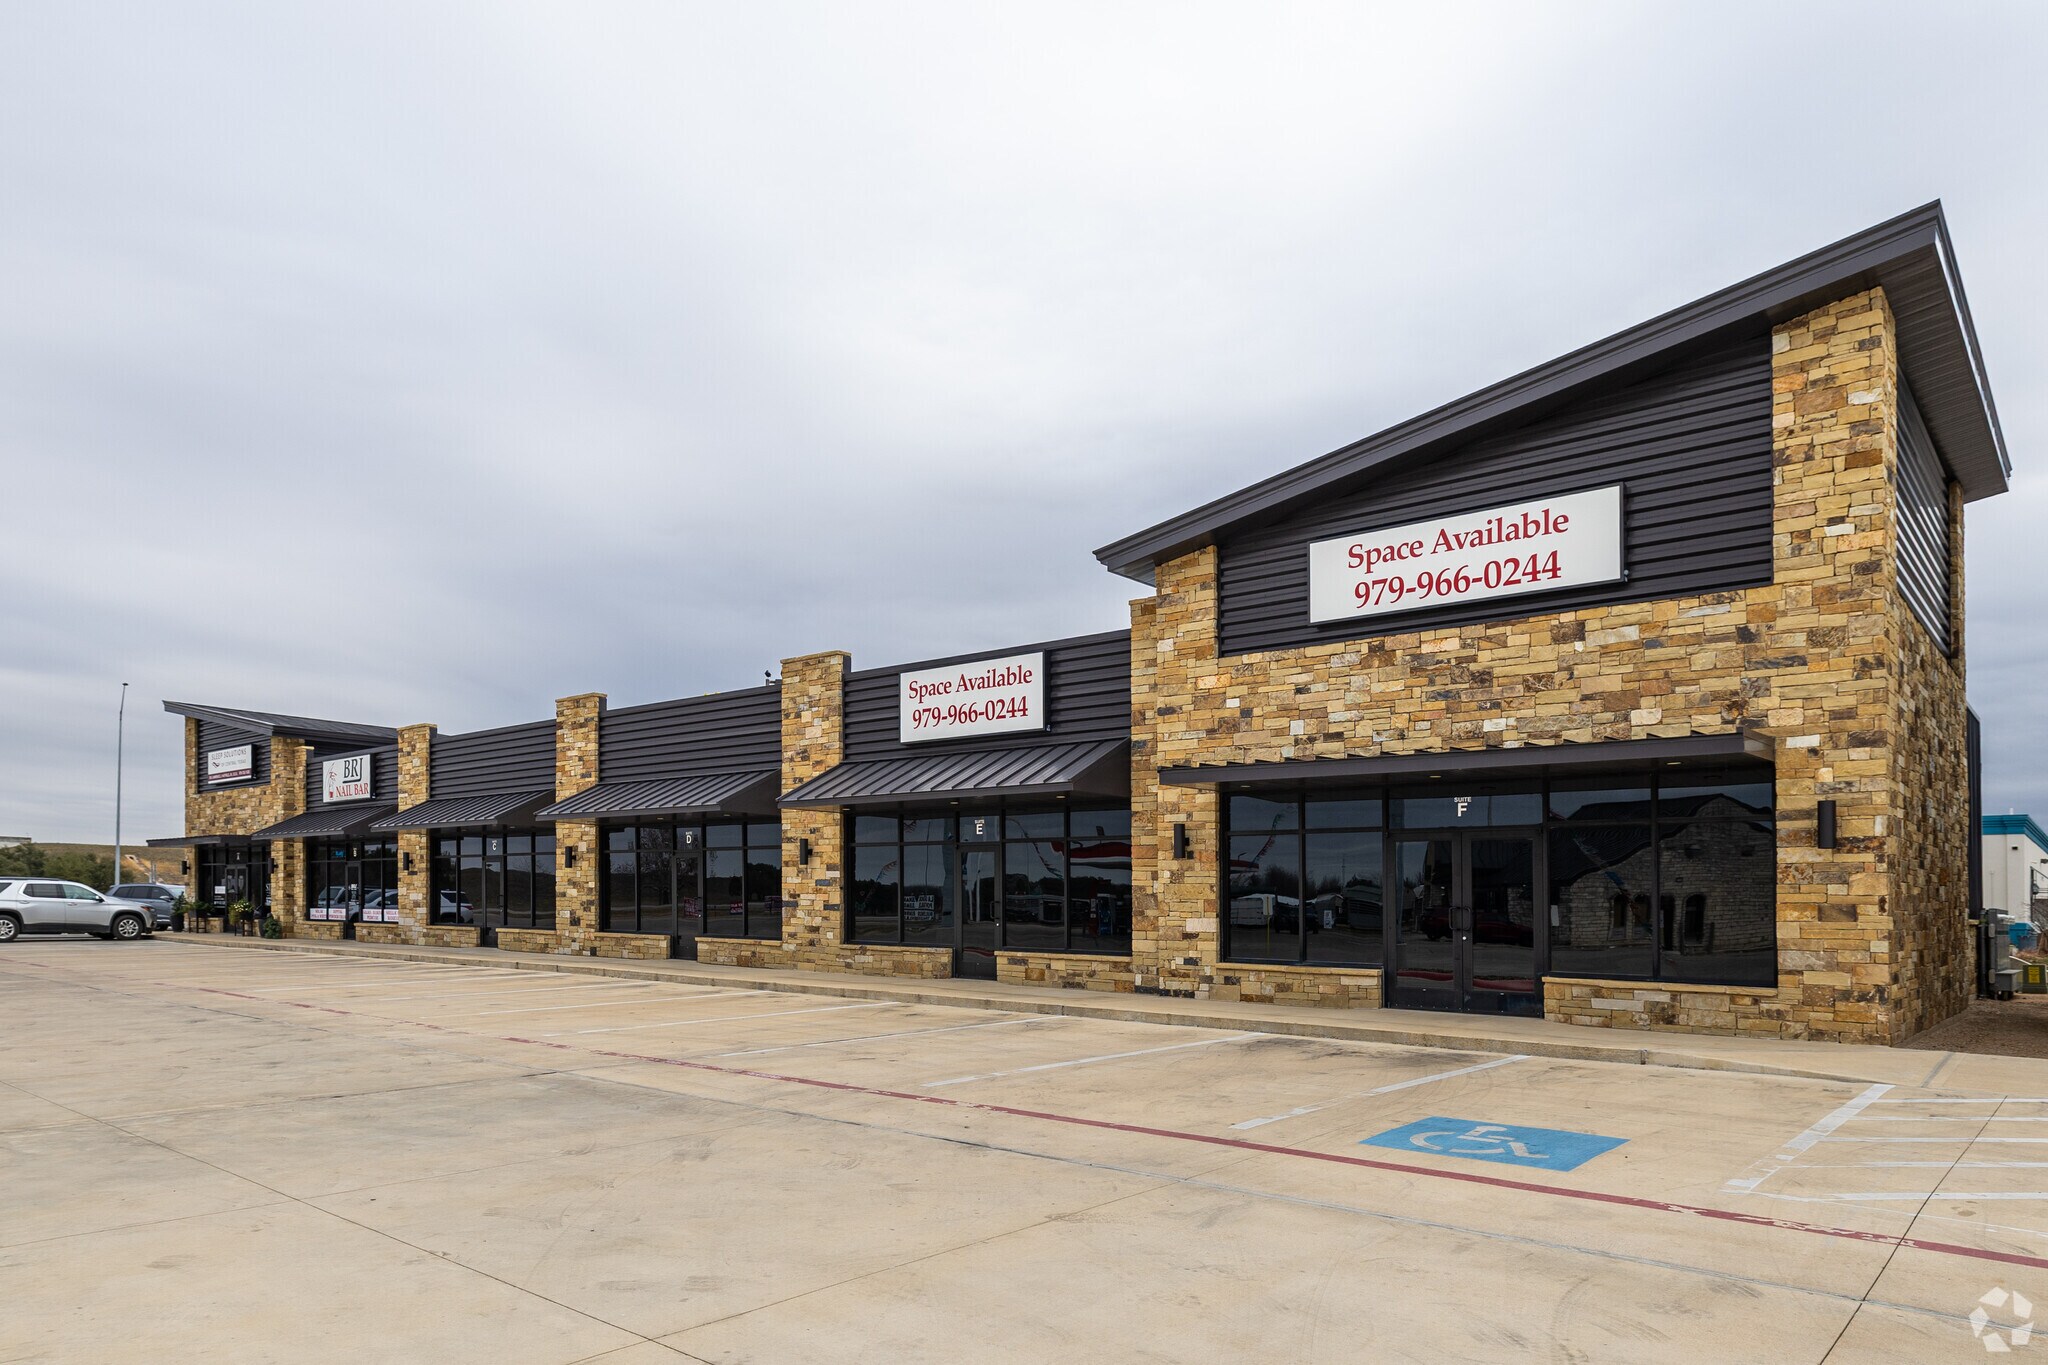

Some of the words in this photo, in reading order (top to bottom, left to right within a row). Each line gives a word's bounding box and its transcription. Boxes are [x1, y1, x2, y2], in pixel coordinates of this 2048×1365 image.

[1347, 540, 1424, 574] Space
[1431, 508, 1570, 554] Available
[1354, 550, 1562, 609] 979-966-0244
[908, 680, 952, 704] Space
[955, 664, 1033, 693] Available
[912, 696, 1029, 730] 979-966-0244
[342, 757, 364, 783] BRJ
[336, 784, 353, 798] NAIL
[354, 782, 369, 796] BAR
[1457, 802, 1468, 817] F
[686, 834, 692, 844] D
[976, 823, 984, 835] E
[492, 842, 497, 851] C
